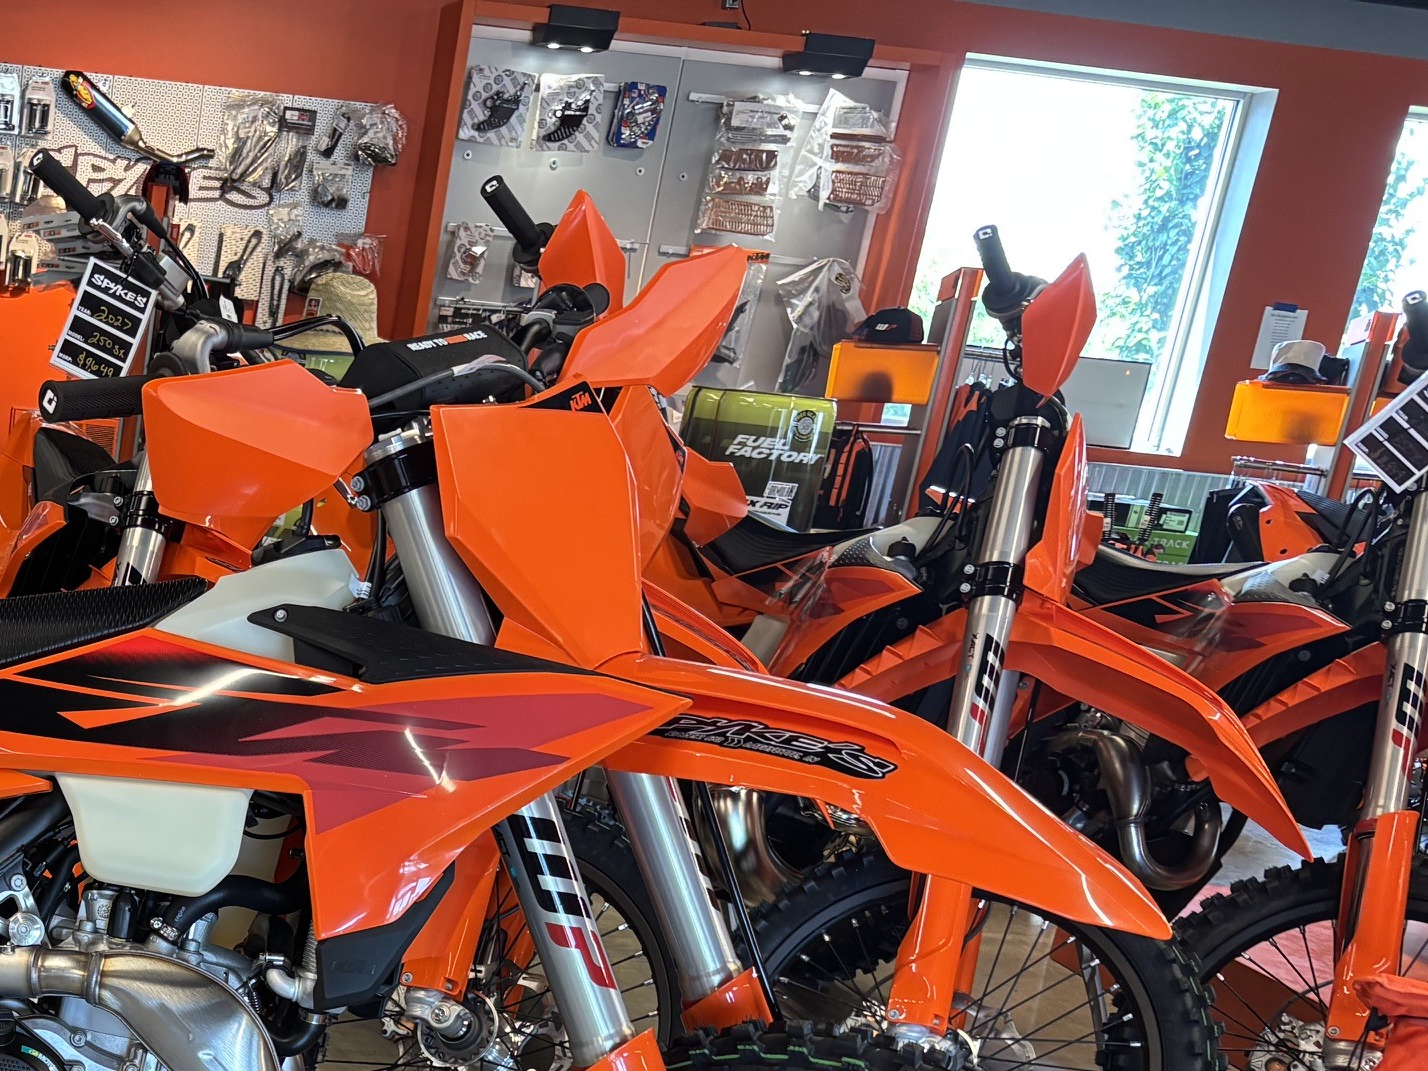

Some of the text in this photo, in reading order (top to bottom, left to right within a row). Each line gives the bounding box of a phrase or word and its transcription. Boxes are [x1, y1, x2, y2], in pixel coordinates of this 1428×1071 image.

[91, 273, 148, 309] SPYKE'S
[77, 305, 132, 330] YEAR: 2027
[88, 332, 113, 348] 250
[406, 330, 488, 351] READY TO RACE
[570, 390, 592, 411] KTM
[732, 434, 791, 451] FUEL
[725, 445, 824, 465] FACTORY
[761, 502, 789, 511] RIP
[658, 713, 897, 778] PYKE'S
[507, 812, 618, 991] WP
